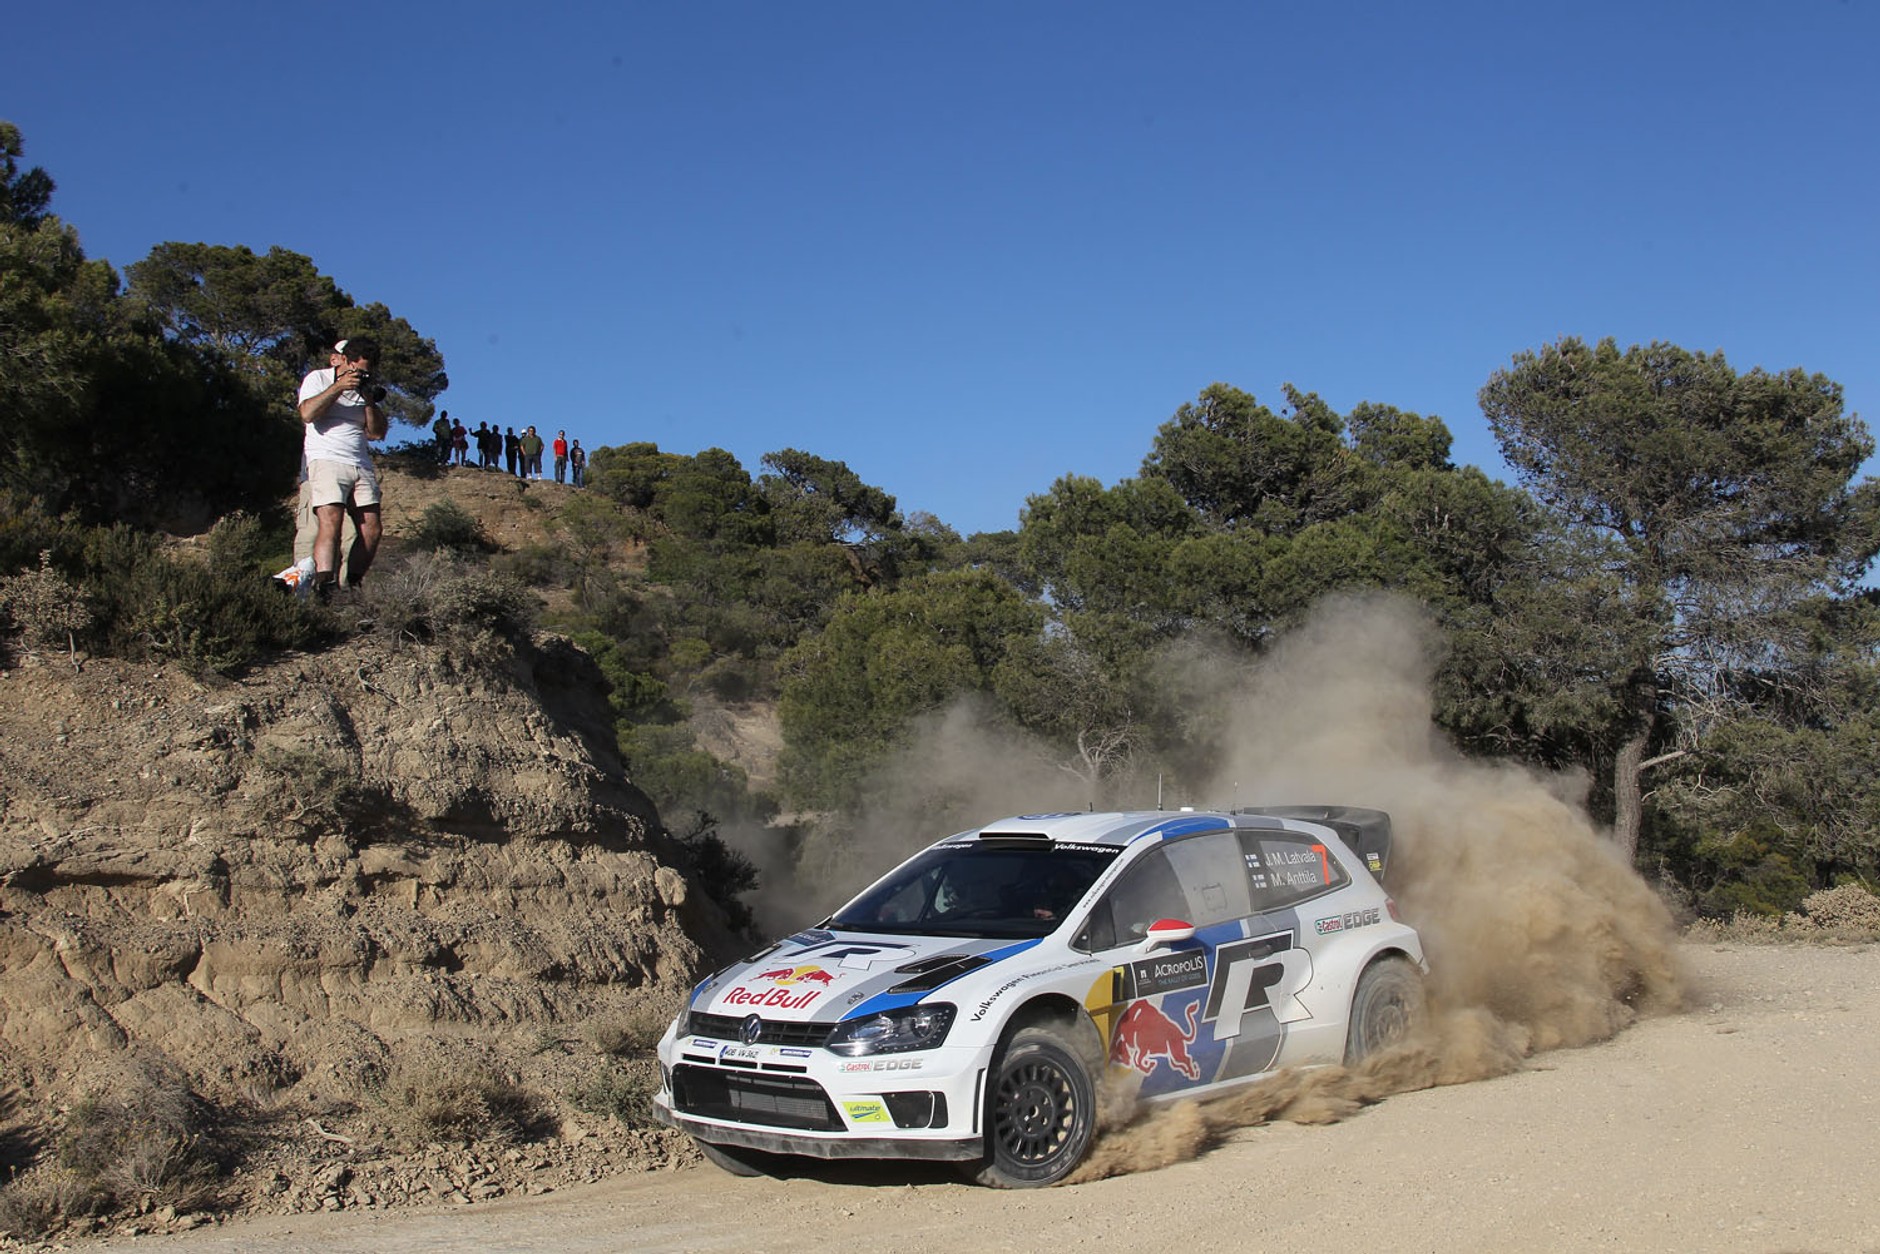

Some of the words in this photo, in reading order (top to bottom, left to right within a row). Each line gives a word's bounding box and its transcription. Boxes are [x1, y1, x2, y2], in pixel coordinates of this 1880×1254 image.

[1054, 843, 1119, 854] Volkswagen
[1285, 850, 1316, 865] Latvala
[1311, 844, 1330, 886] 7
[1271, 873, 1285, 887] M.
[1287, 870, 1317, 884] Anttila
[1343, 908, 1381, 930] EDGE
[1154, 956, 1204, 978] ACROPOLIS
[723, 987, 775, 1004] Red
[766, 988, 821, 1009] Bull
[970, 975, 1024, 1022] Volkswagen
[846, 1062, 870, 1072] Castrol
[873, 1059, 923, 1071] EDGE
[850, 1104, 881, 1112] ultimate
